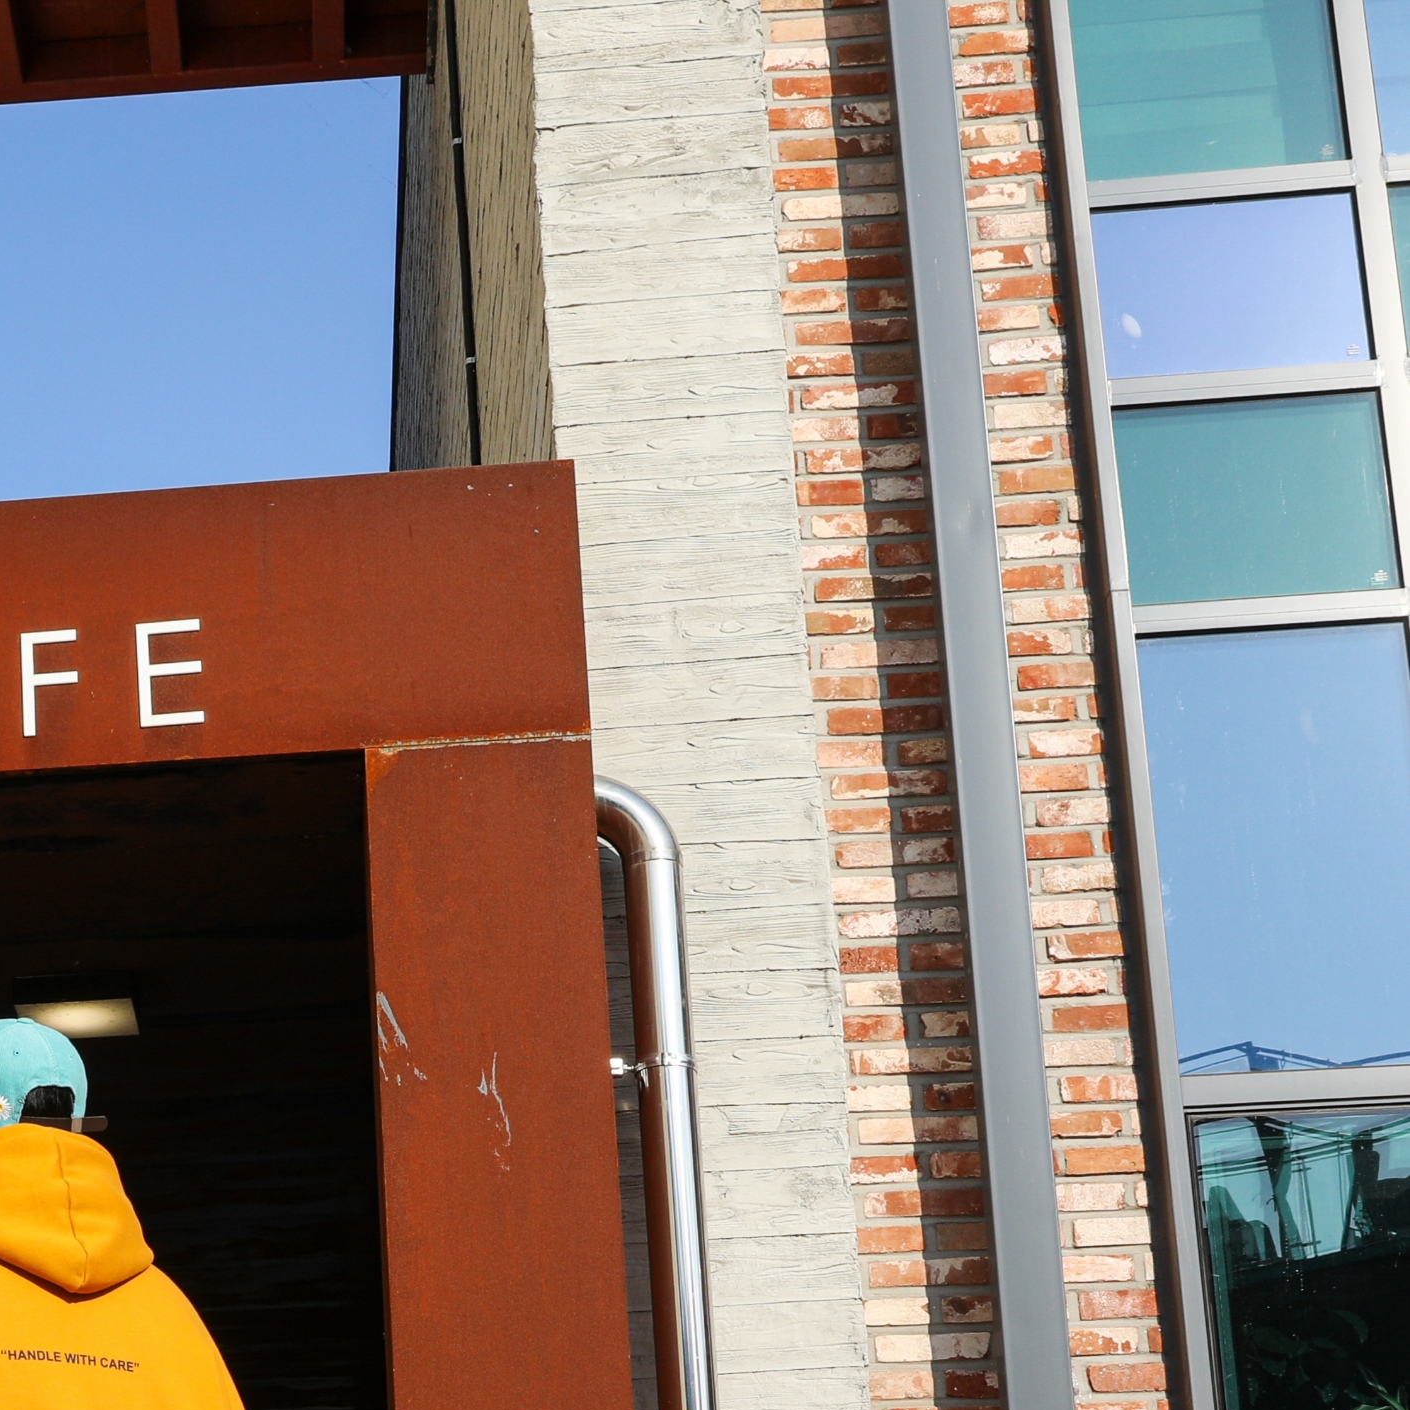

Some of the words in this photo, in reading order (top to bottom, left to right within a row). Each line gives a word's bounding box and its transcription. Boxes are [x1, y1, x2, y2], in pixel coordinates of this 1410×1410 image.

[0, 1350, 62, 1362] “HANDLE
[64, 1353, 97, 1366] WITH
[100, 1357, 140, 1372] CARE”
